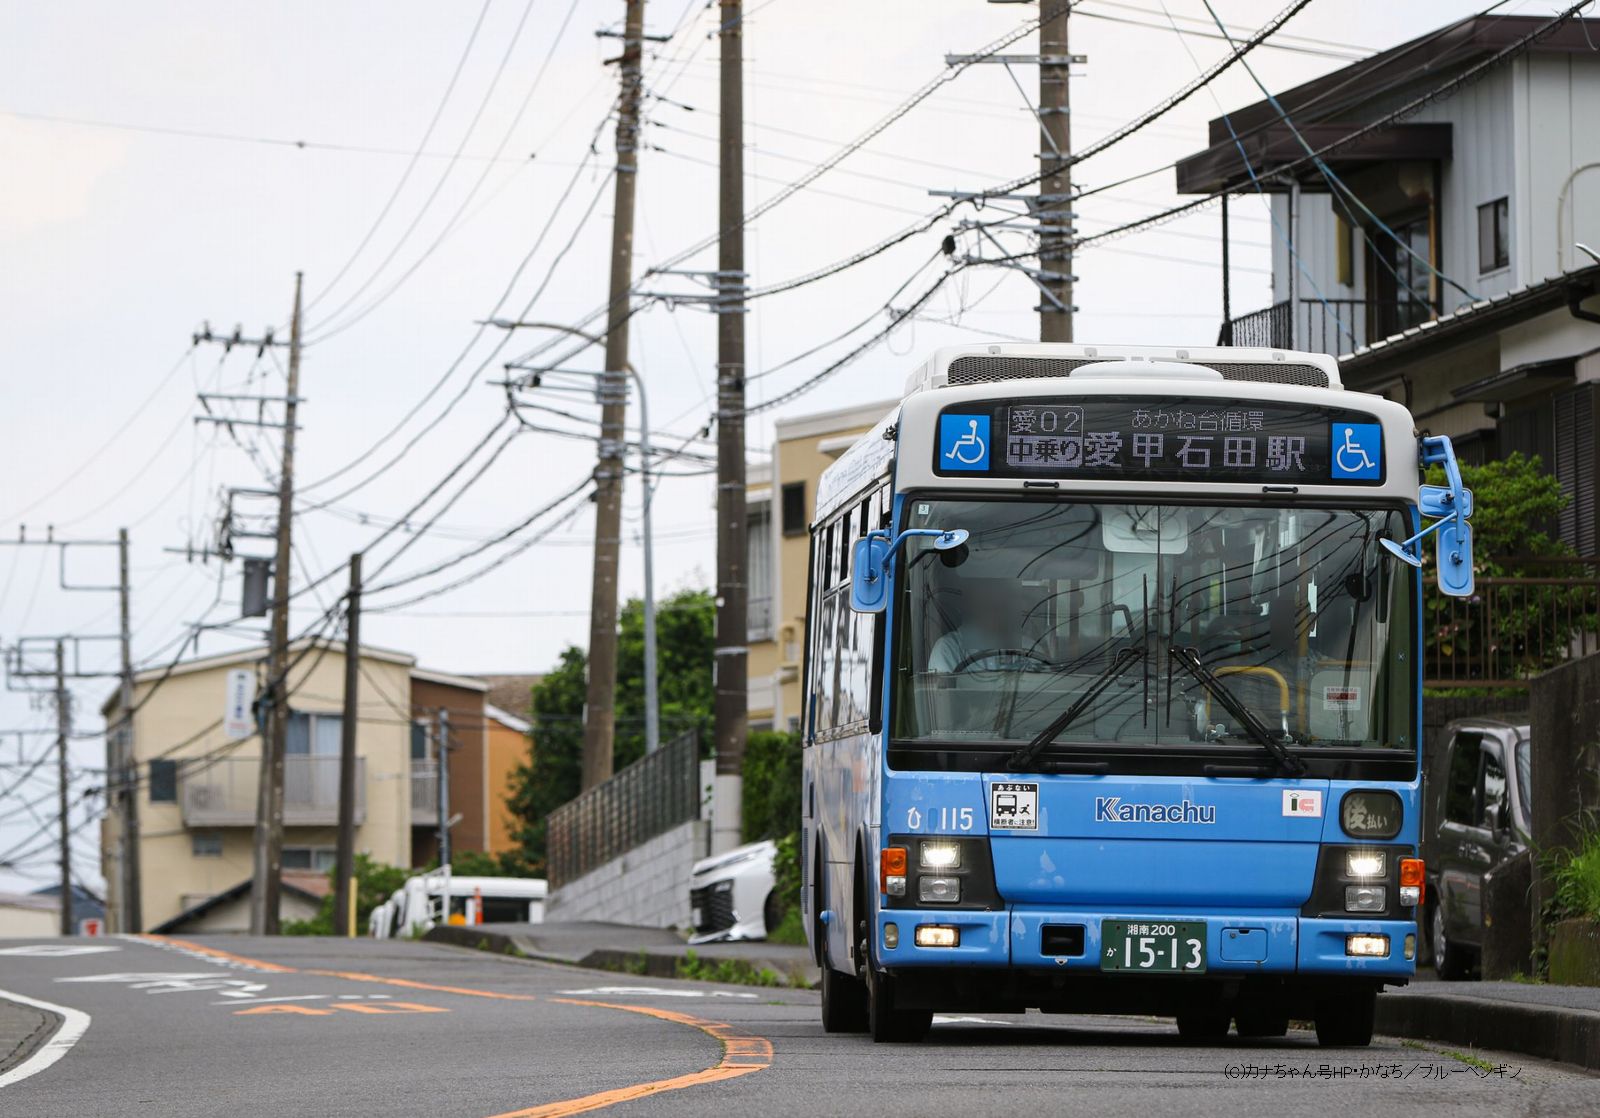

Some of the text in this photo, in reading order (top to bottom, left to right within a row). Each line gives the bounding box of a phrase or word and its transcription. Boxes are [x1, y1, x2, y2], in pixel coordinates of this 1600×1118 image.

[1012, 409, 1080, 433] 愛02
[1131, 409, 1264, 431] あかね台循環
[1009, 438, 1080, 462] 中乗り
[1083, 431, 1306, 472] 愛甲石田駅
[907, 806, 974, 831] ひ 115
[1096, 797, 1216, 824] Kanachu
[1343, 797, 1388, 830] 後払い
[1106, 937, 1202, 969] か 15-13
